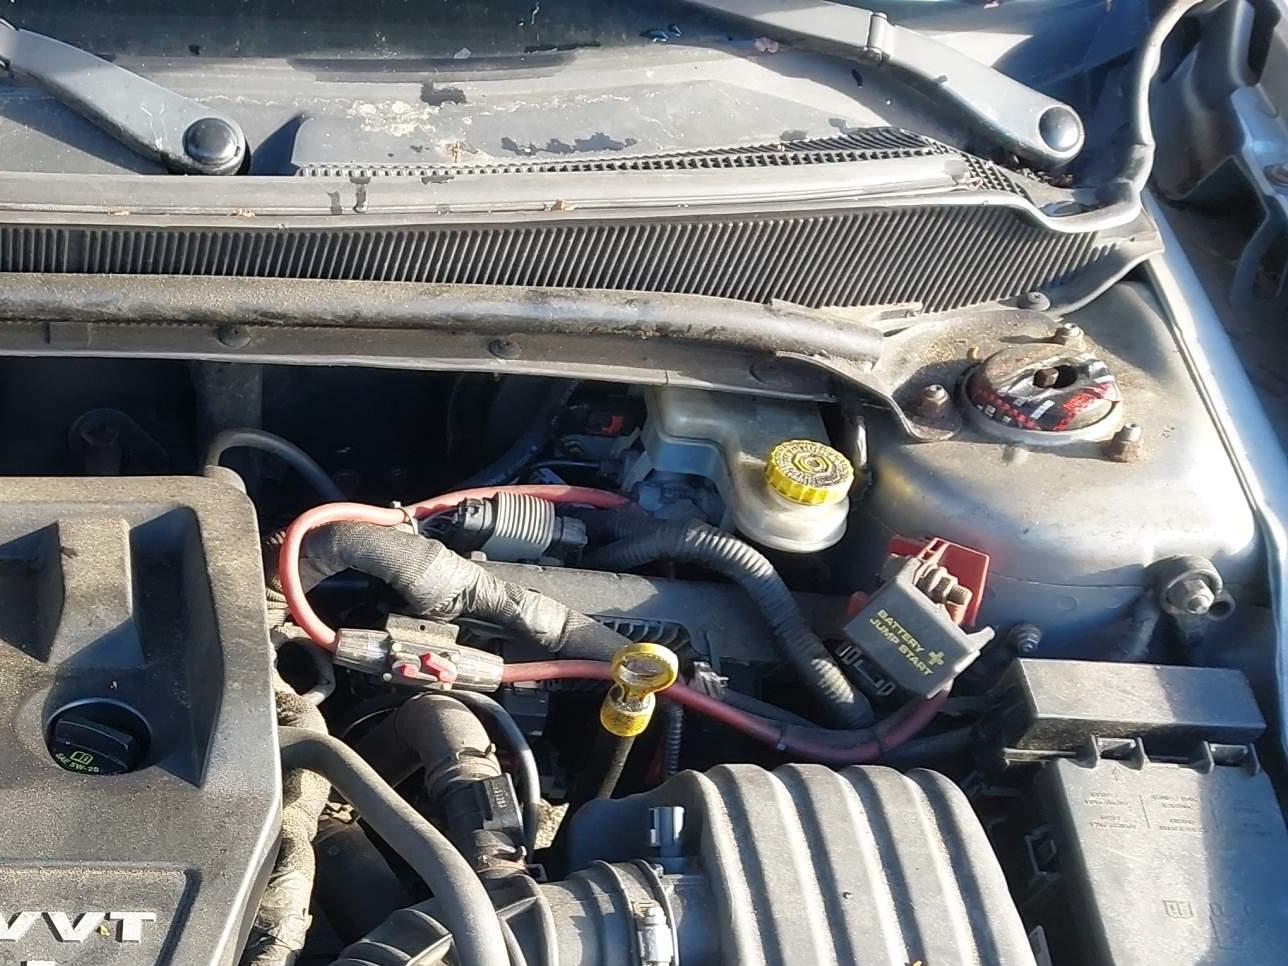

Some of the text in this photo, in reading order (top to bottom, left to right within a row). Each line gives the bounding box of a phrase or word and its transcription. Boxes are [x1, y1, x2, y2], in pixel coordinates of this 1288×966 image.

[869, 617, 934, 675] JUMP START
[877, 609, 925, 652] BATTERY
[55, 752, 100, 773] SAE 5W-20
